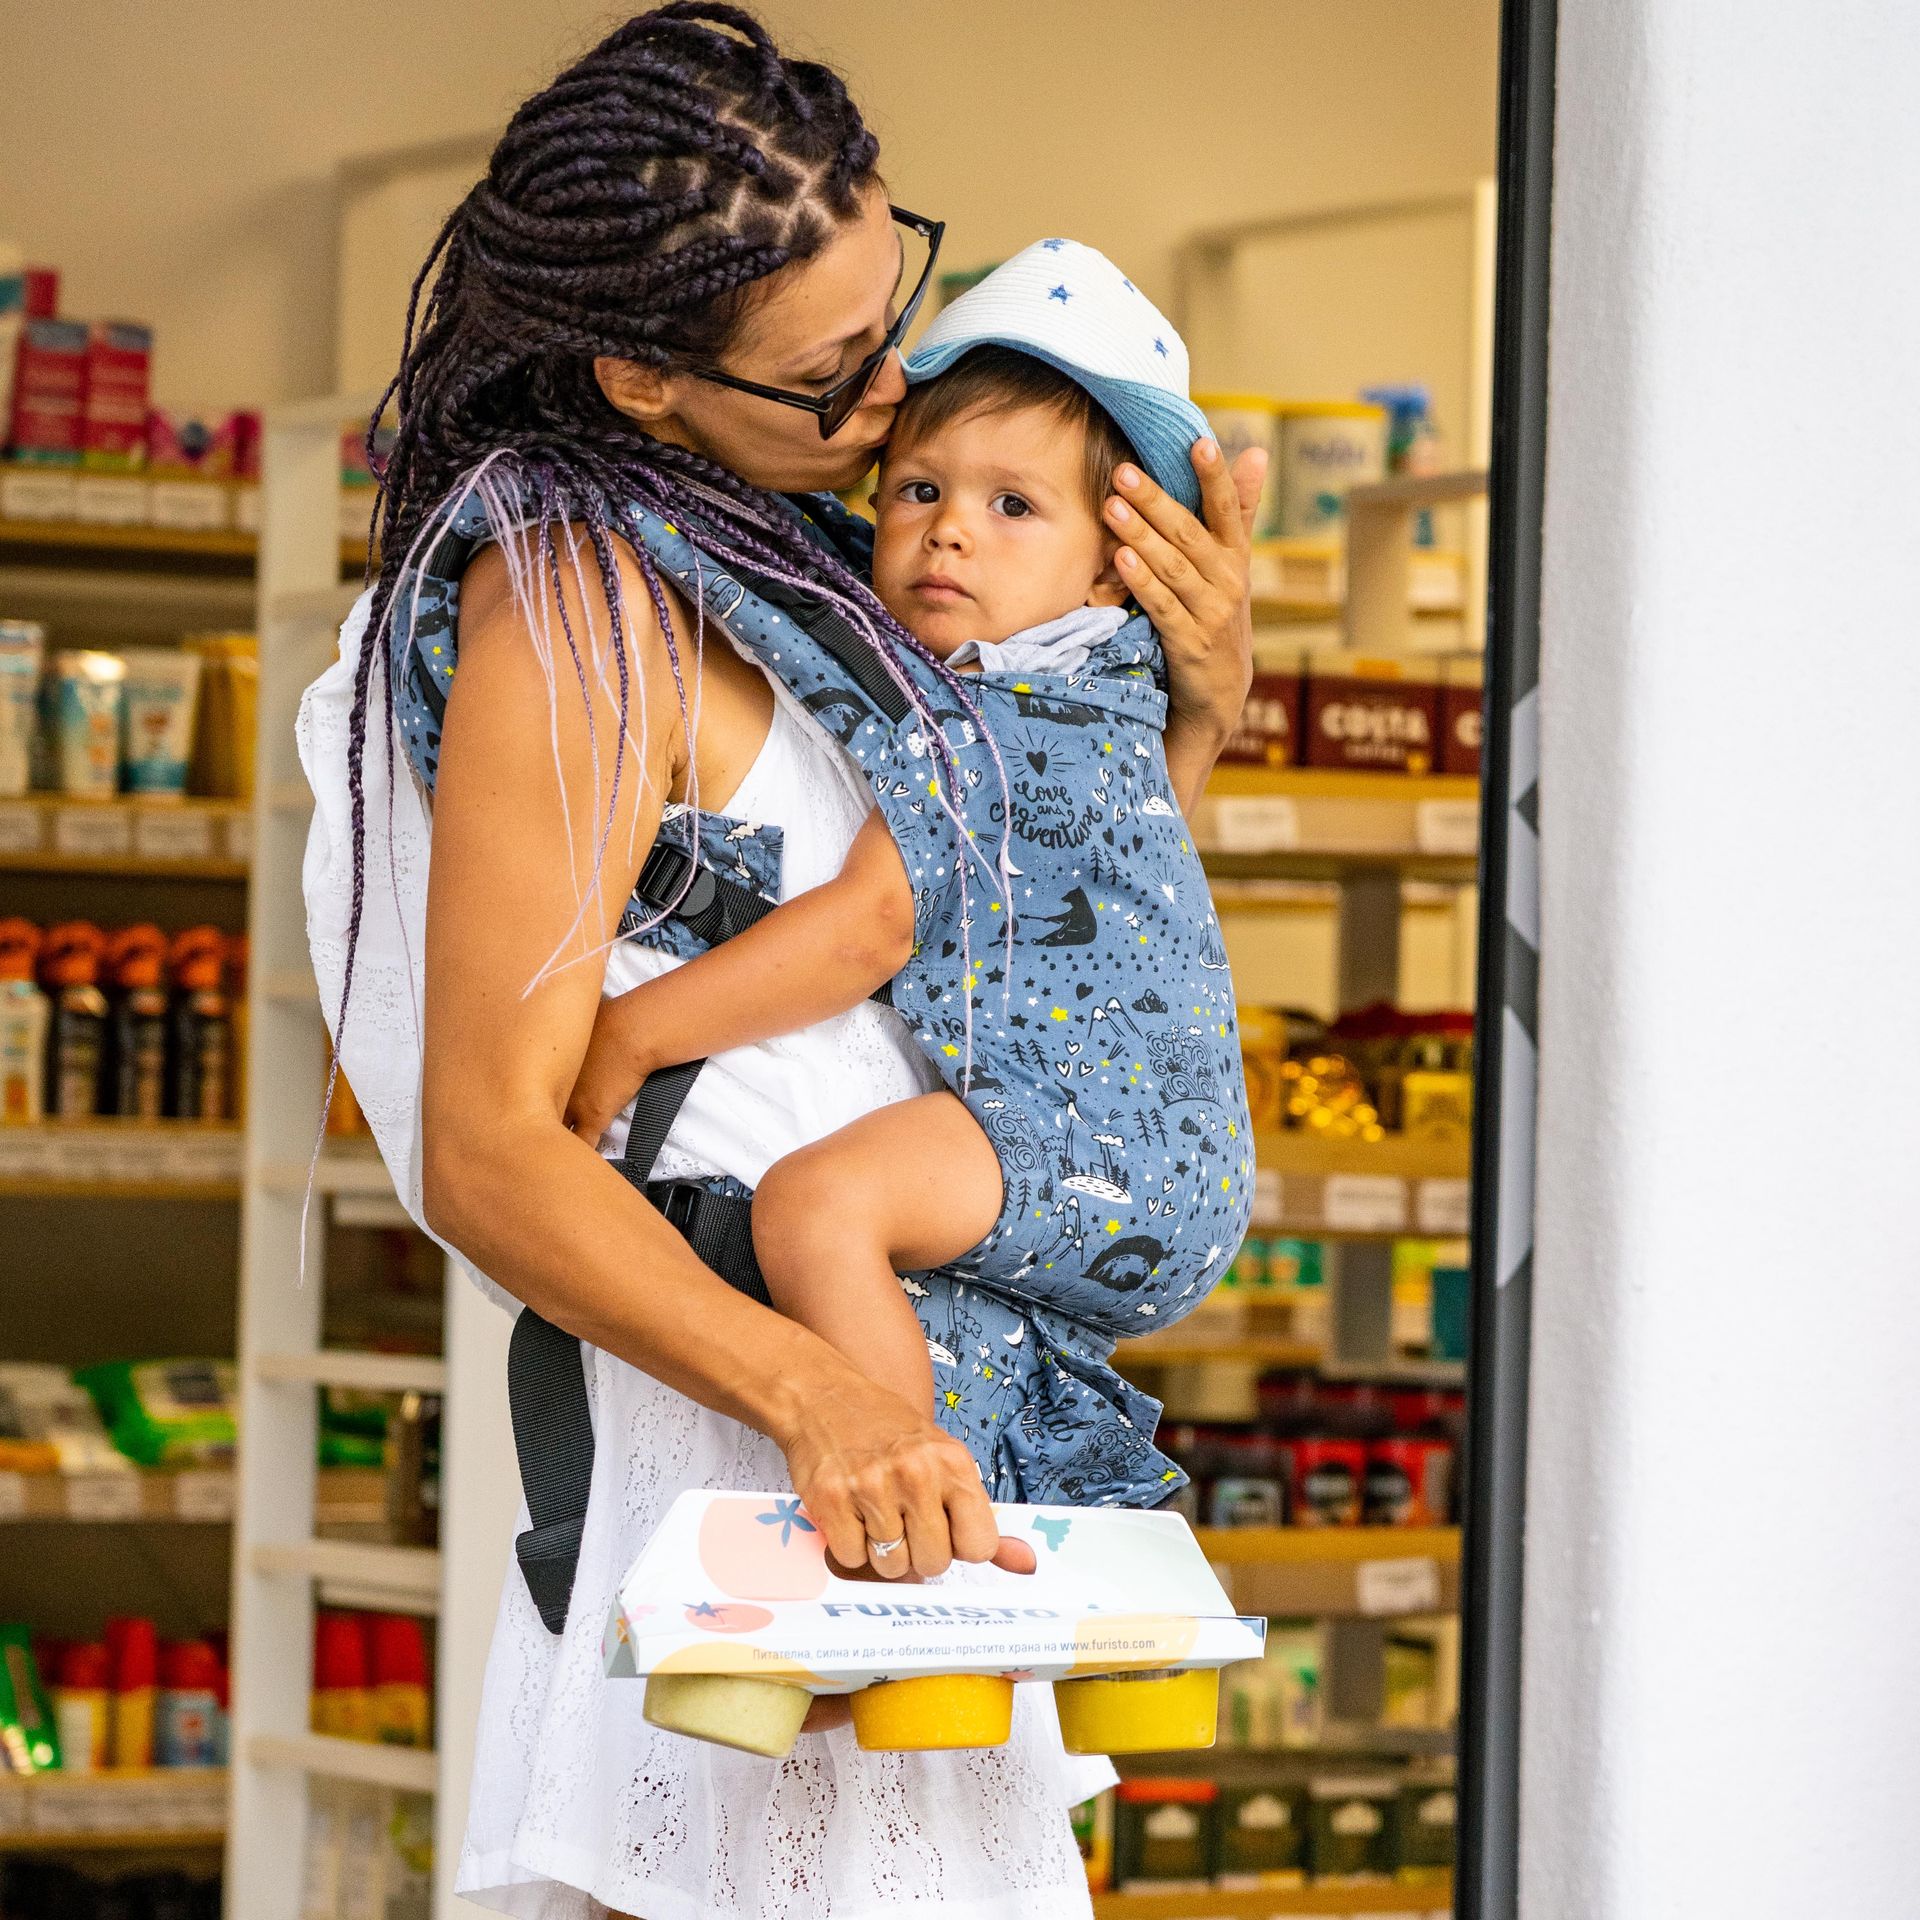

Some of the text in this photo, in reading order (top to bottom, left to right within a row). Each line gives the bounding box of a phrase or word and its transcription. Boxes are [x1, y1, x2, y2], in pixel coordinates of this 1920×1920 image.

[1037, 804, 1066, 817] and
[820, 1603, 1060, 1619] FURISTO
[816, 1647, 849, 1659] силна
[853, 1648, 860, 1657] и
[1008, 1642, 1041, 1656] храна
[1044, 1643, 1057, 1653] на
[1060, 1638, 1155, 1651] www.furisto.com
